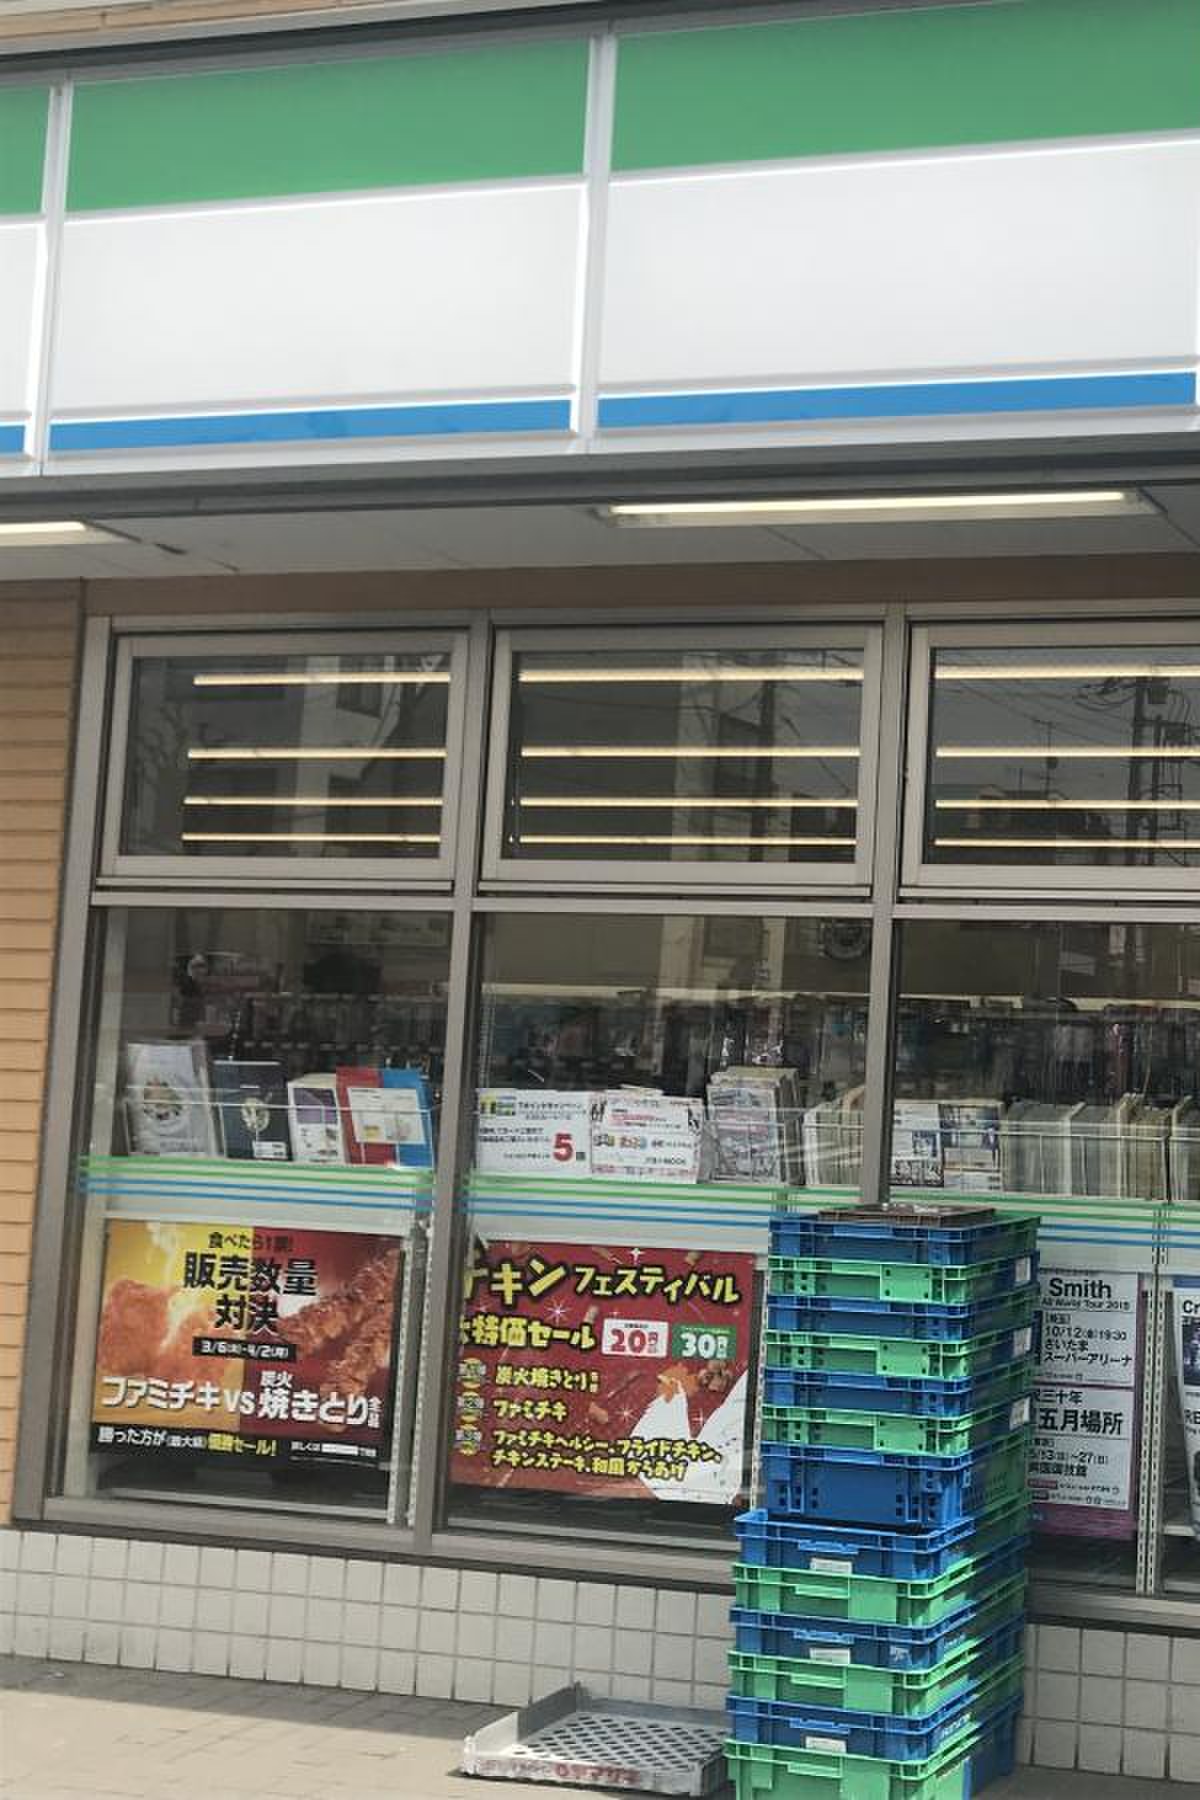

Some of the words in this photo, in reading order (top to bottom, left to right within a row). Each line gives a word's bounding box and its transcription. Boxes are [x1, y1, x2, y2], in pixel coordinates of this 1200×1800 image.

[183, 1251, 318, 1296] 販売数量
[1049, 1278, 1112, 1299] Smith
[214, 1296, 279, 1333] 対決
[1044, 1339, 1089, 1352] さいたま
[1043, 1352, 1133, 1366] スーパーアリーナ
[101, 1376, 221, 1411] ファミチキ
[257, 1387, 368, 1426] 焼きとり
[493, 1399, 568, 1421] ファミチキ
[1038, 1408, 1123, 1436] 五月場所
